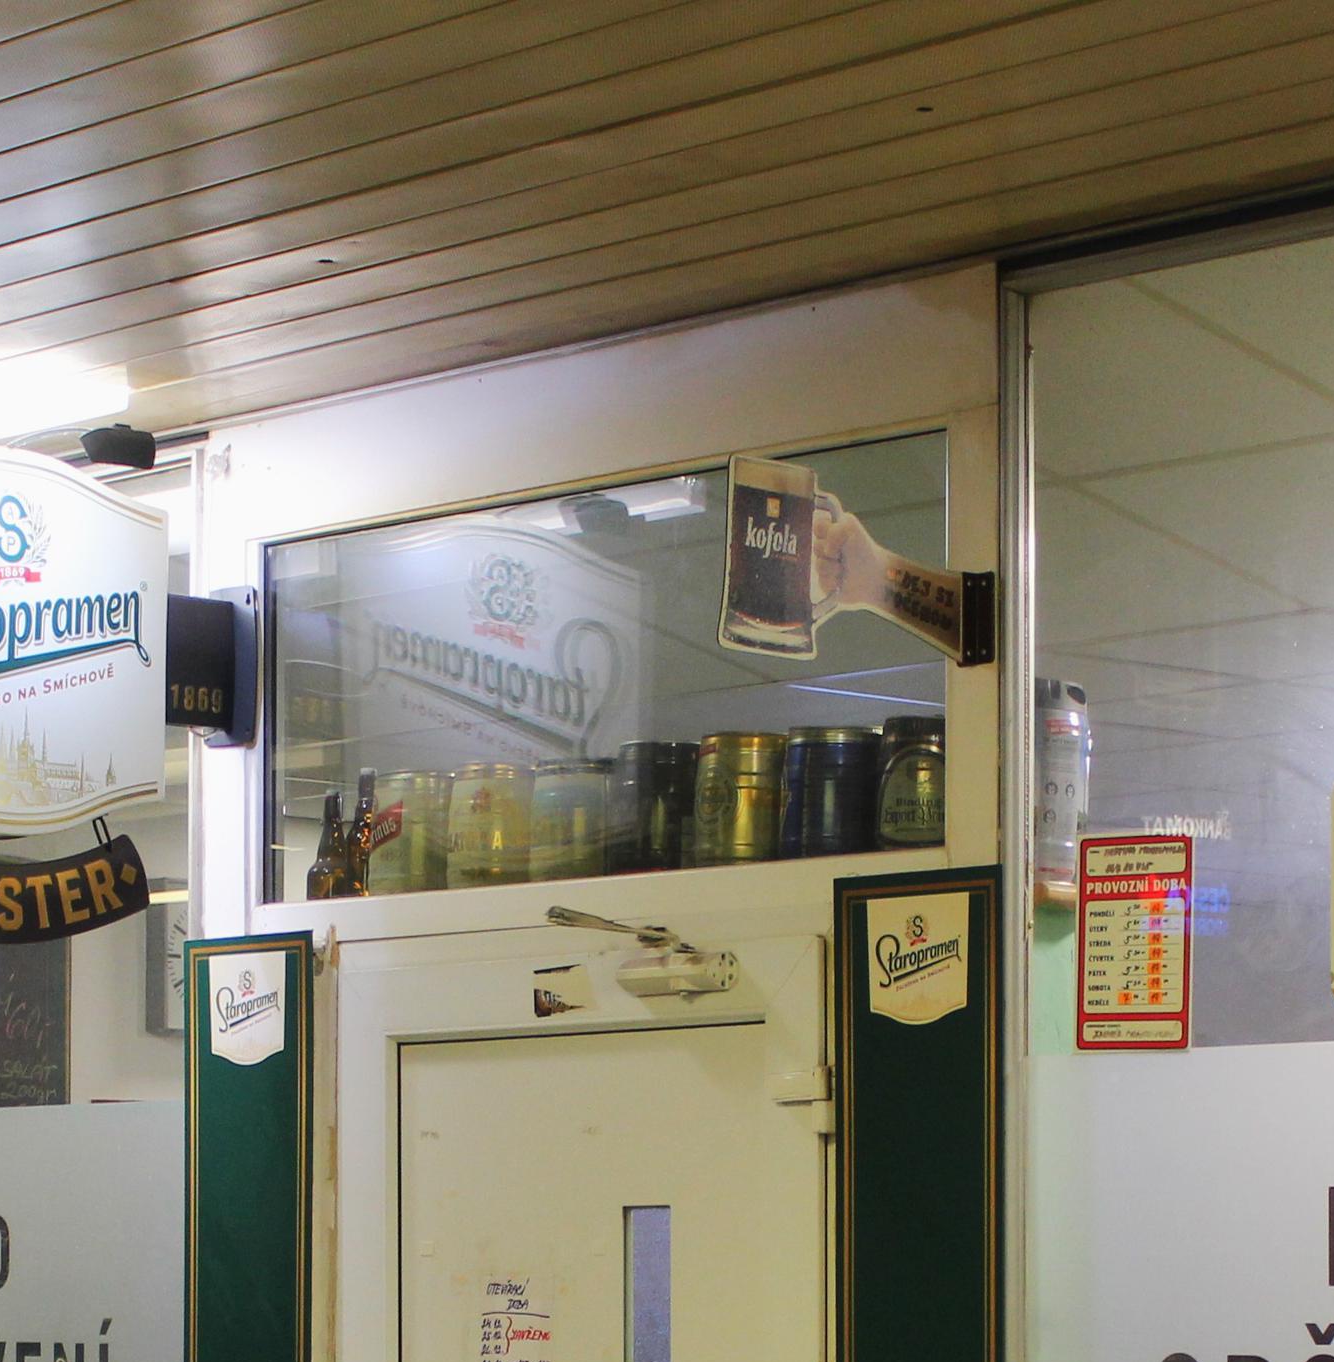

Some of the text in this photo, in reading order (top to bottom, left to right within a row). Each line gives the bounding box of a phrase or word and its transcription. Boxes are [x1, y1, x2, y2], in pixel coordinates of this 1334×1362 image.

[745, 516, 797, 558] kofola
[0, 567, 25, 578] 1869
[18, 686, 37, 701] NA
[43, 663, 114, 695] SMÍCHOVĚ
[170, 684, 223, 714] 1869
[1086, 875, 1187, 896] PROVOZNÍ DOBA
[875, 934, 962, 988] Staropramen
[216, 986, 280, 1033] Staropramen
